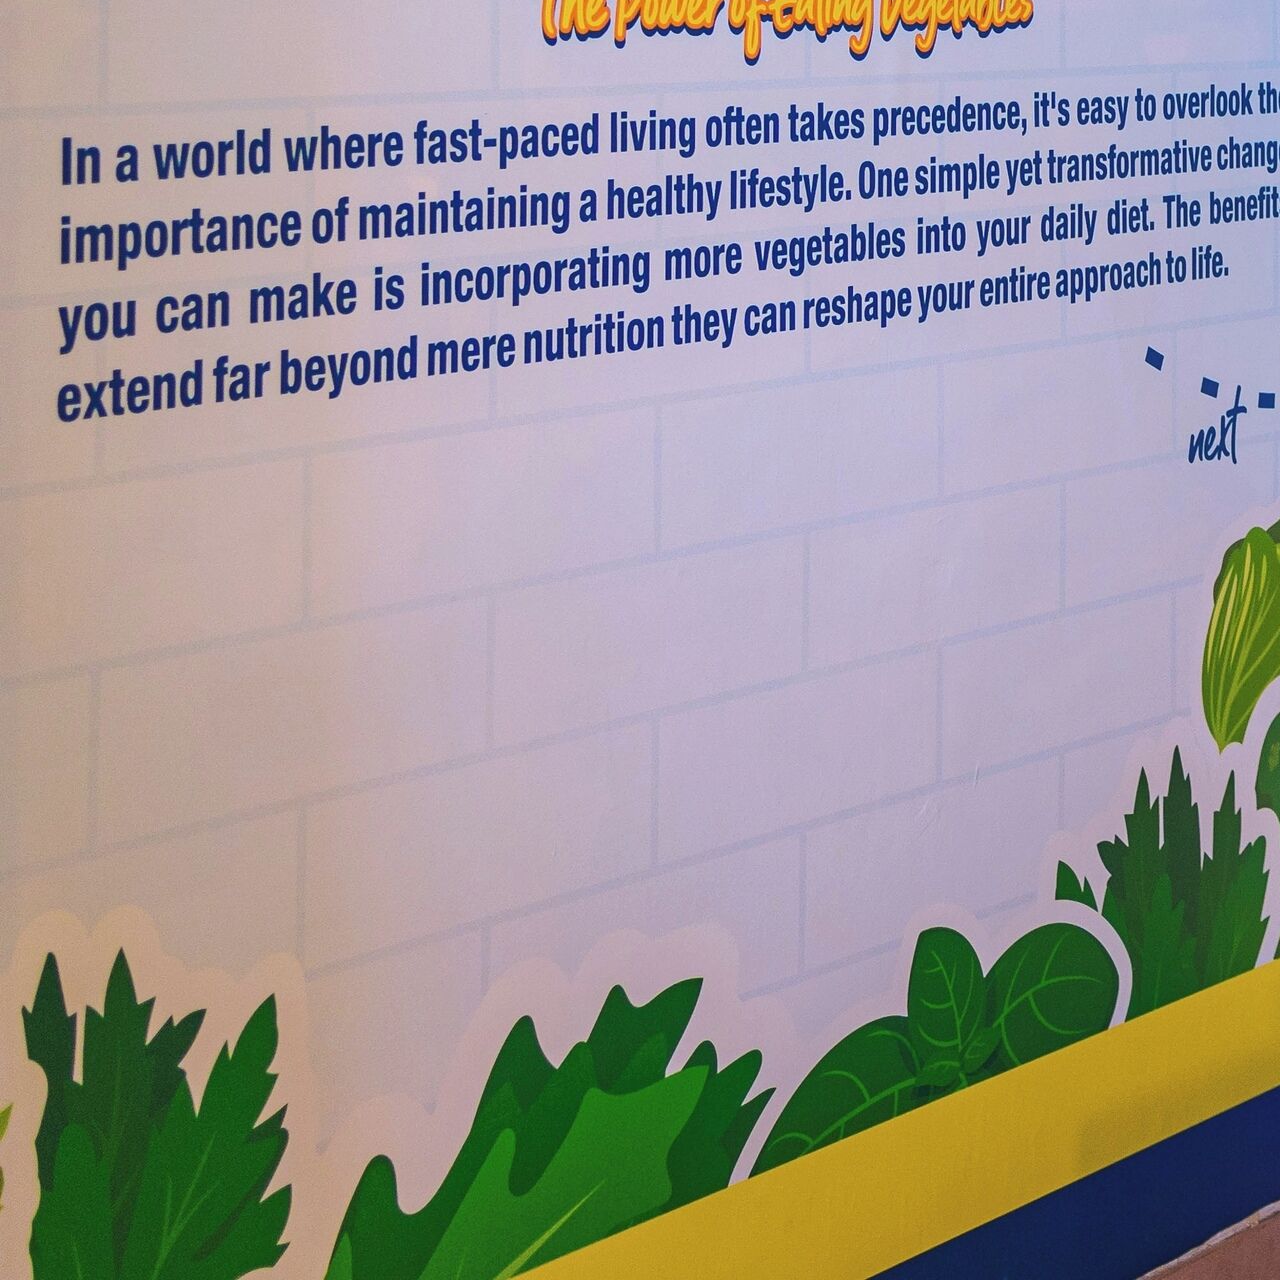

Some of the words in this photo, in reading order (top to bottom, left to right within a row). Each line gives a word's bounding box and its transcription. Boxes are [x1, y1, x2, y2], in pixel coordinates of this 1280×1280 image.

[61, 136, 101, 186] In
[115, 144, 139, 183] a
[152, 127, 271, 180] world
[283, 125, 404, 172] where
[413, 112, 599, 170] fast-paced
[610, 109, 696, 159] living
[705, 105, 780, 148] often
[787, 101, 865, 143] takes
[873, 95, 1028, 138] precedence,
[1033, 91, 1070, 128] it's
[1076, 95, 1130, 132] easy
[1134, 87, 1157, 123] to
[1162, 82, 1254, 121] overlook
[60, 207, 302, 272] importance
[311, 196, 350, 245] of
[359, 184, 571, 241] maintaining
[579, 189, 598, 223] a
[607, 173, 723, 222] healthy
[730, 163, 852, 213] lifestyle.
[858, 160, 909, 200] One
[914, 153, 1000, 200] simple
[1005, 150, 1043, 196] yet
[1046, 138, 1213, 184] transformative
[58, 300, 137, 356] you
[155, 290, 230, 334] can
[249, 272, 357, 324] make
[374, 266, 405, 311] is
[421, 245, 651, 307] incorporating
[664, 242, 743, 281] more
[754, 221, 906, 277] vegetables
[917, 215, 967, 255] into
[976, 215, 1032, 258] your
[1040, 202, 1098, 246] daily
[1107, 197, 1155, 236] diet.
[1162, 194, 1202, 230] The
[1188, 385, 1247, 464] next
